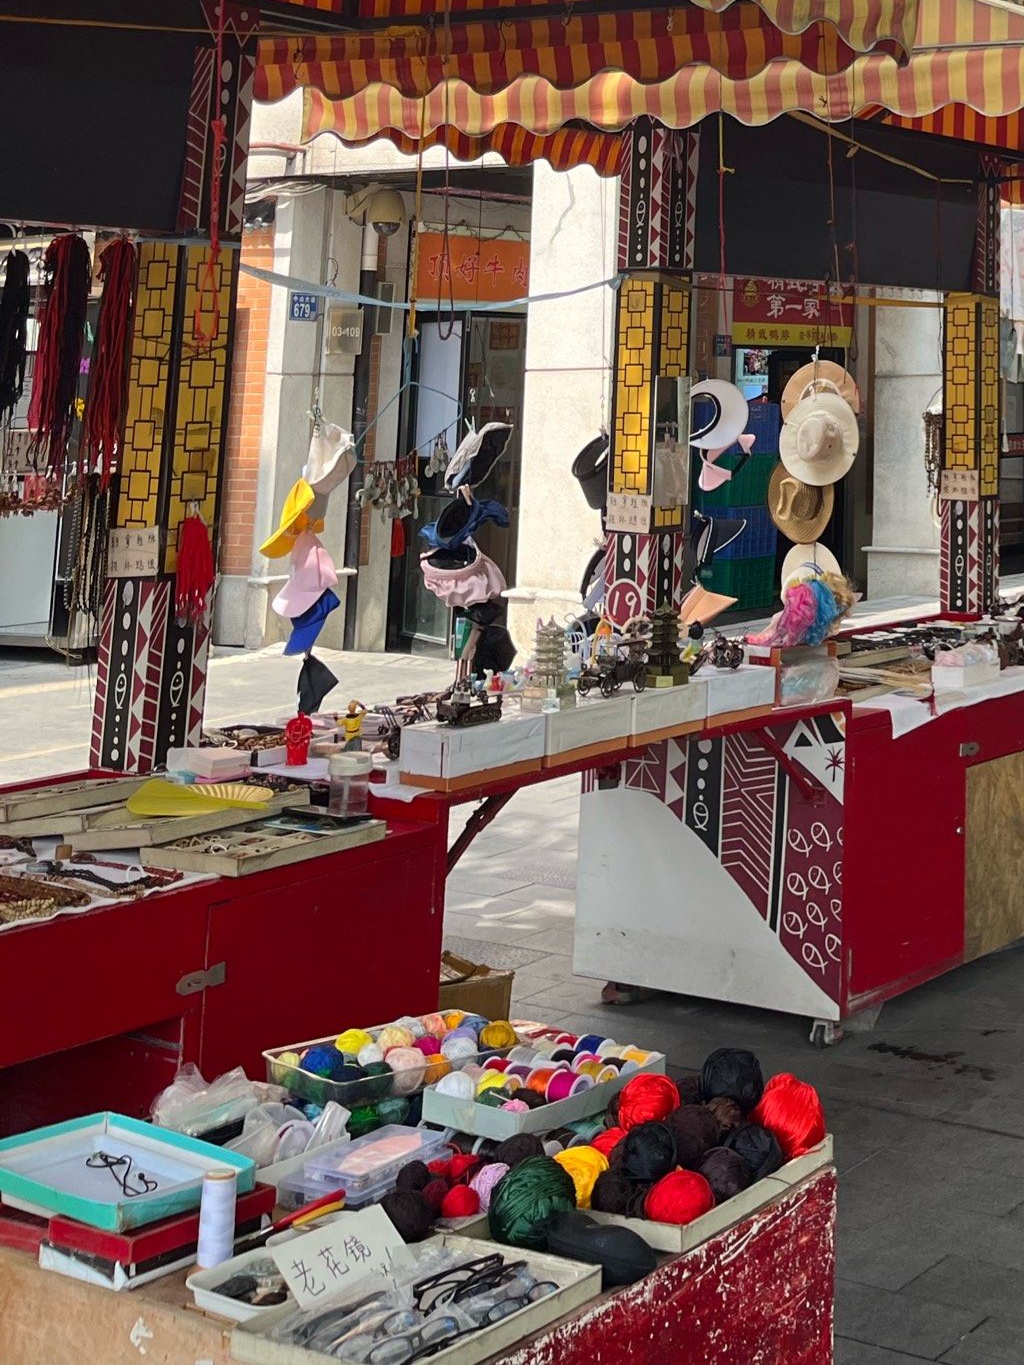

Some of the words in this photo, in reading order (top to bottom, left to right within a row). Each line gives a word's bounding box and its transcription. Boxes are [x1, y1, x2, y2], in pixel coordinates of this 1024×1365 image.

[428, 251, 528, 288] 顶好牛肉
[294, 303, 310, 317] 679
[767, 295, 820, 319] 第一家
[612, 590, 638, 617] 19
[291, 1235, 371, 1296] 老花镜
